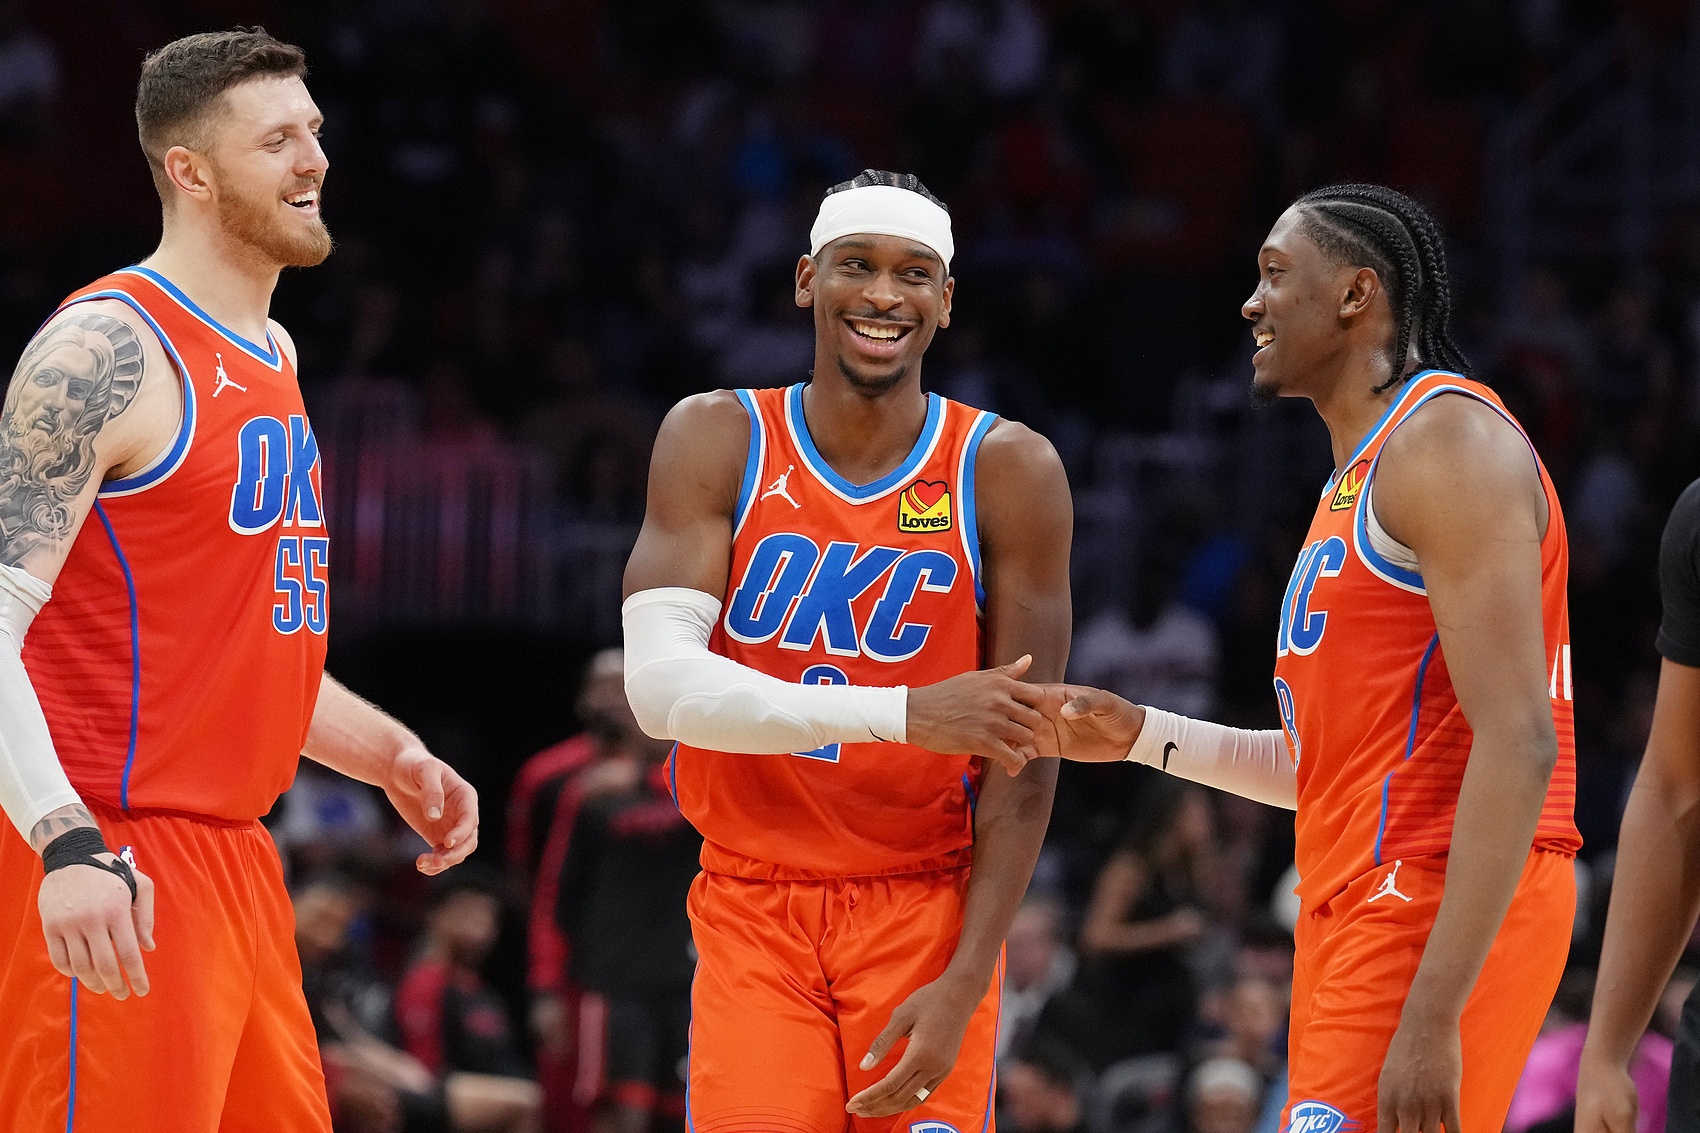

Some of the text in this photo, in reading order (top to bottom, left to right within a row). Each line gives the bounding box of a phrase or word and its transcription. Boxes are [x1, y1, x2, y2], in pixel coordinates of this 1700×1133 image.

[228, 414, 327, 535] OK
[272, 536, 330, 635] 55
[723, 532, 958, 663] OKC
